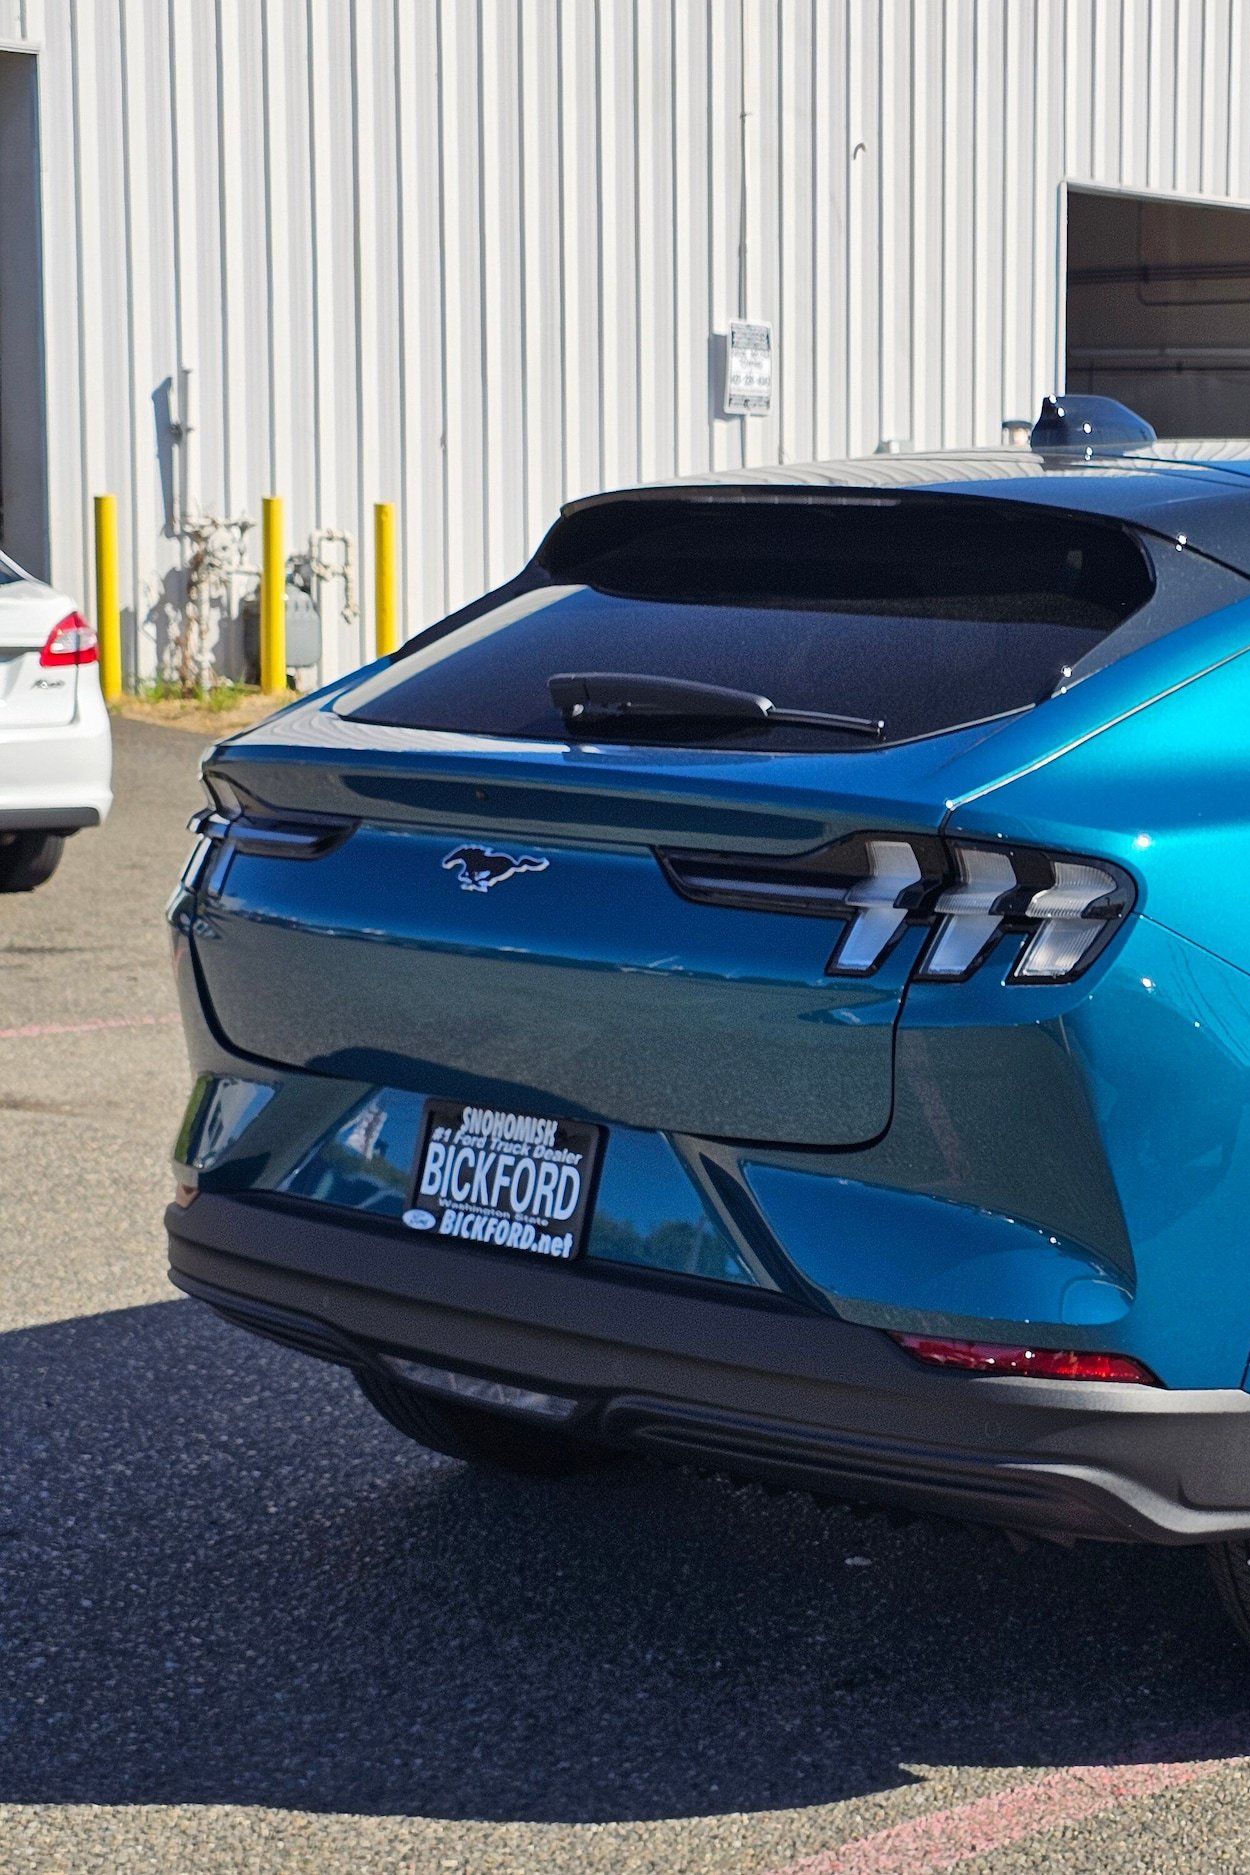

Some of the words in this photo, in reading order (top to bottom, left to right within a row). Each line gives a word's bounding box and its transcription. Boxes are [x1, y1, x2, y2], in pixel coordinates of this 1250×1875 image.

[452, 1129, 487, 1149] Ford
[490, 1138, 532, 1156] Truck
[532, 1145, 583, 1165] Dealer
[419, 1141, 581, 1221] BICKFORD
[439, 1208, 574, 1259] BICKFORD.net
